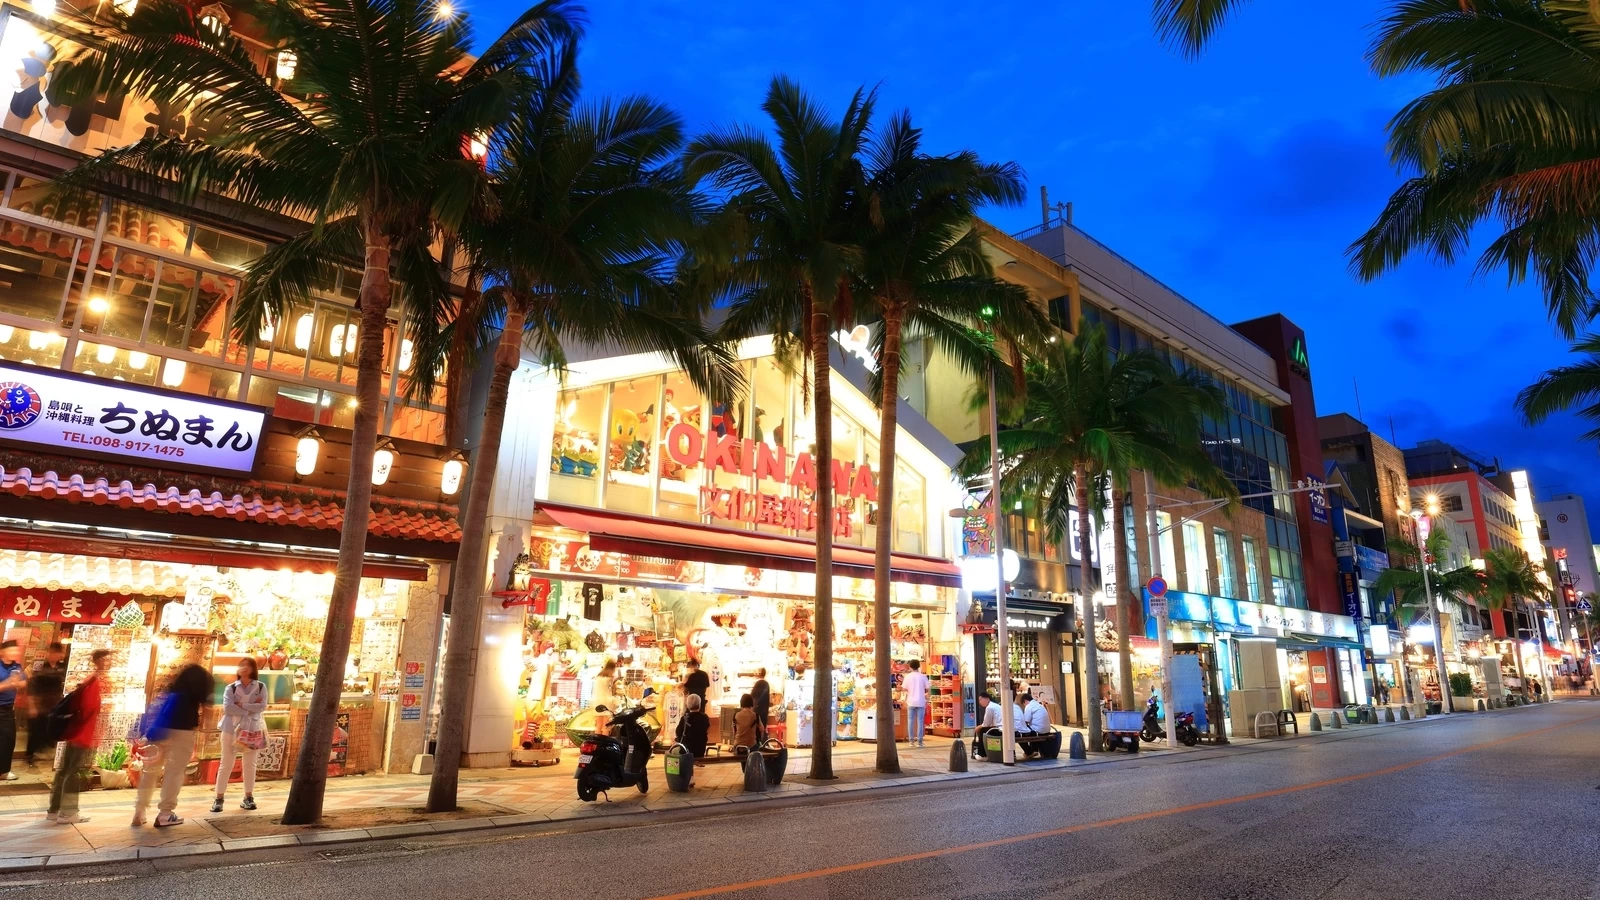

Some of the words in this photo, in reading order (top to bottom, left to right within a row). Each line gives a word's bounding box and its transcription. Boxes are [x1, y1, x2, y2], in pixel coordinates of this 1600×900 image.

[45, 410, 95, 427] 沖縄料理
[47, 400, 84, 415] 島唄と
[99, 401, 253, 452] ちぬまん
[62, 430, 185, 458] TEL:098-917-1475
